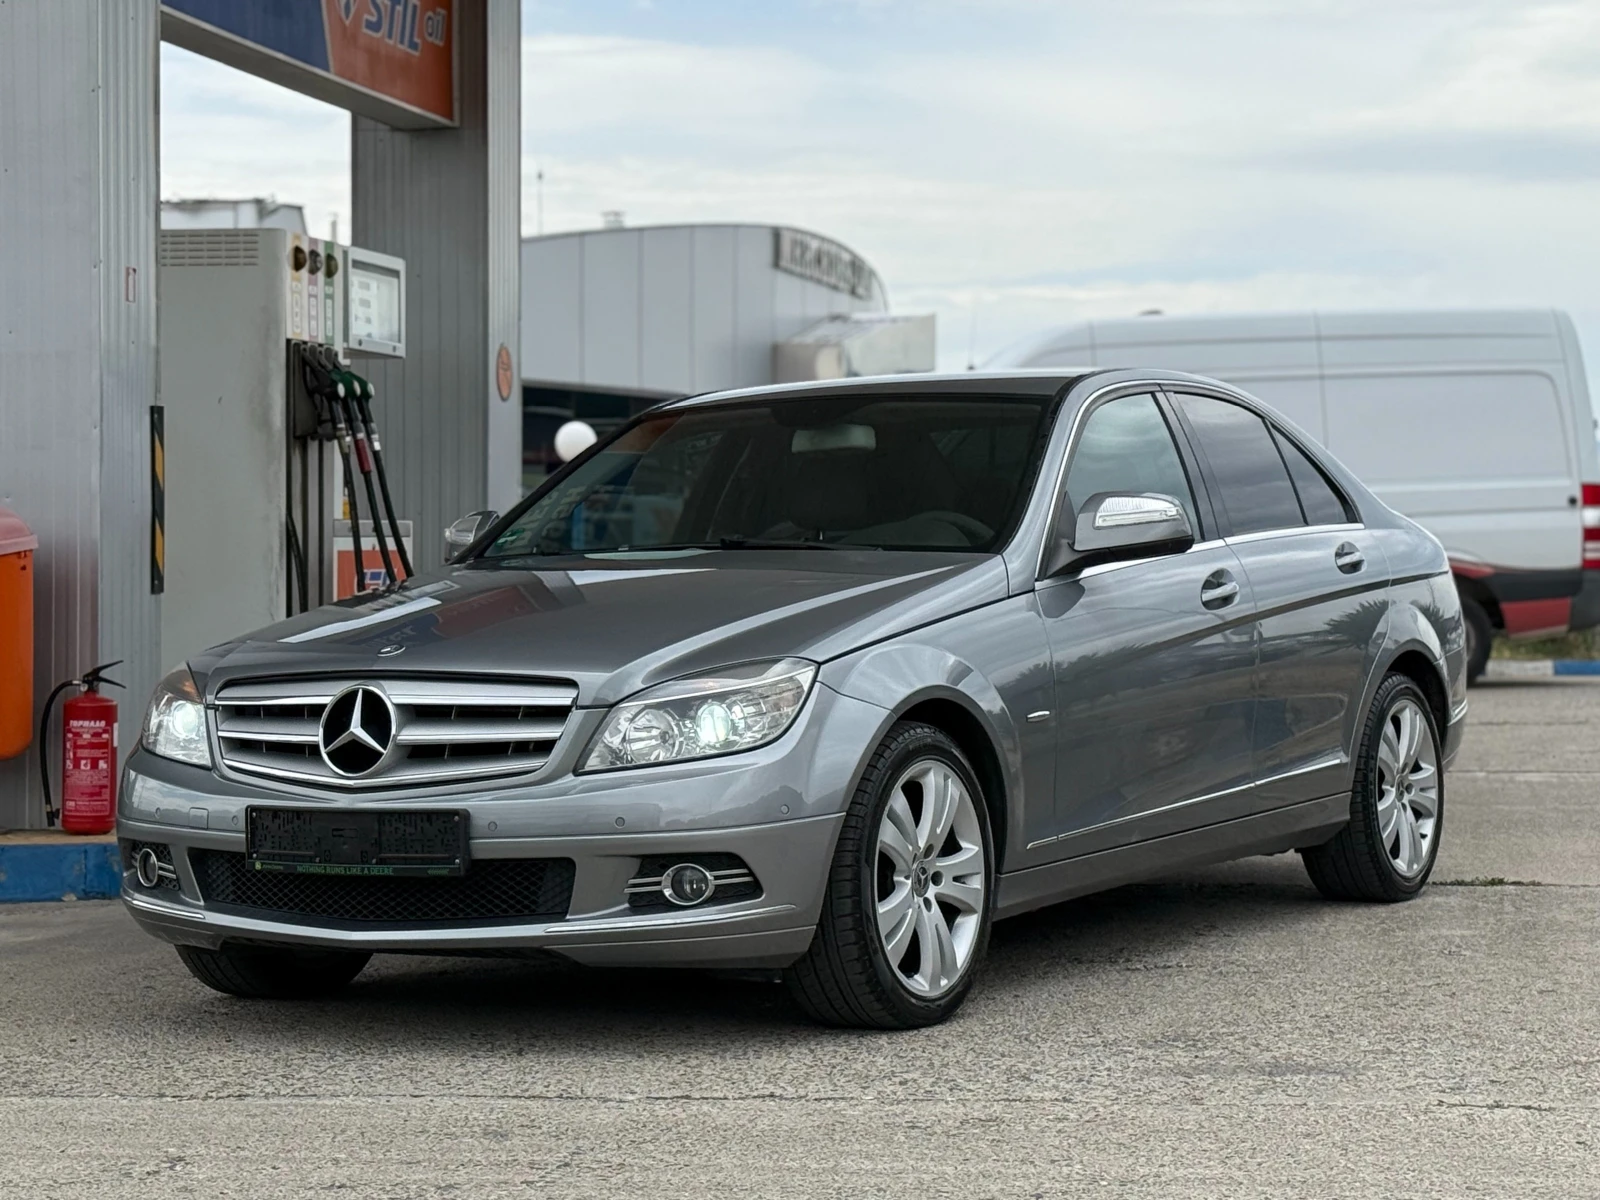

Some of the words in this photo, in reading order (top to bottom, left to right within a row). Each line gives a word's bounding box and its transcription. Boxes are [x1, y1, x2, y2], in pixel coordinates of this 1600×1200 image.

[362, 0, 421, 56] STIL
[424, 7, 447, 47] oil
[296, 864, 325, 874] NOTHING
[326, 866, 345, 875] RUNS
[346, 866, 363, 875] LIKE
[363, 867, 369, 875] A
[370, 867, 395, 876] DEERE
